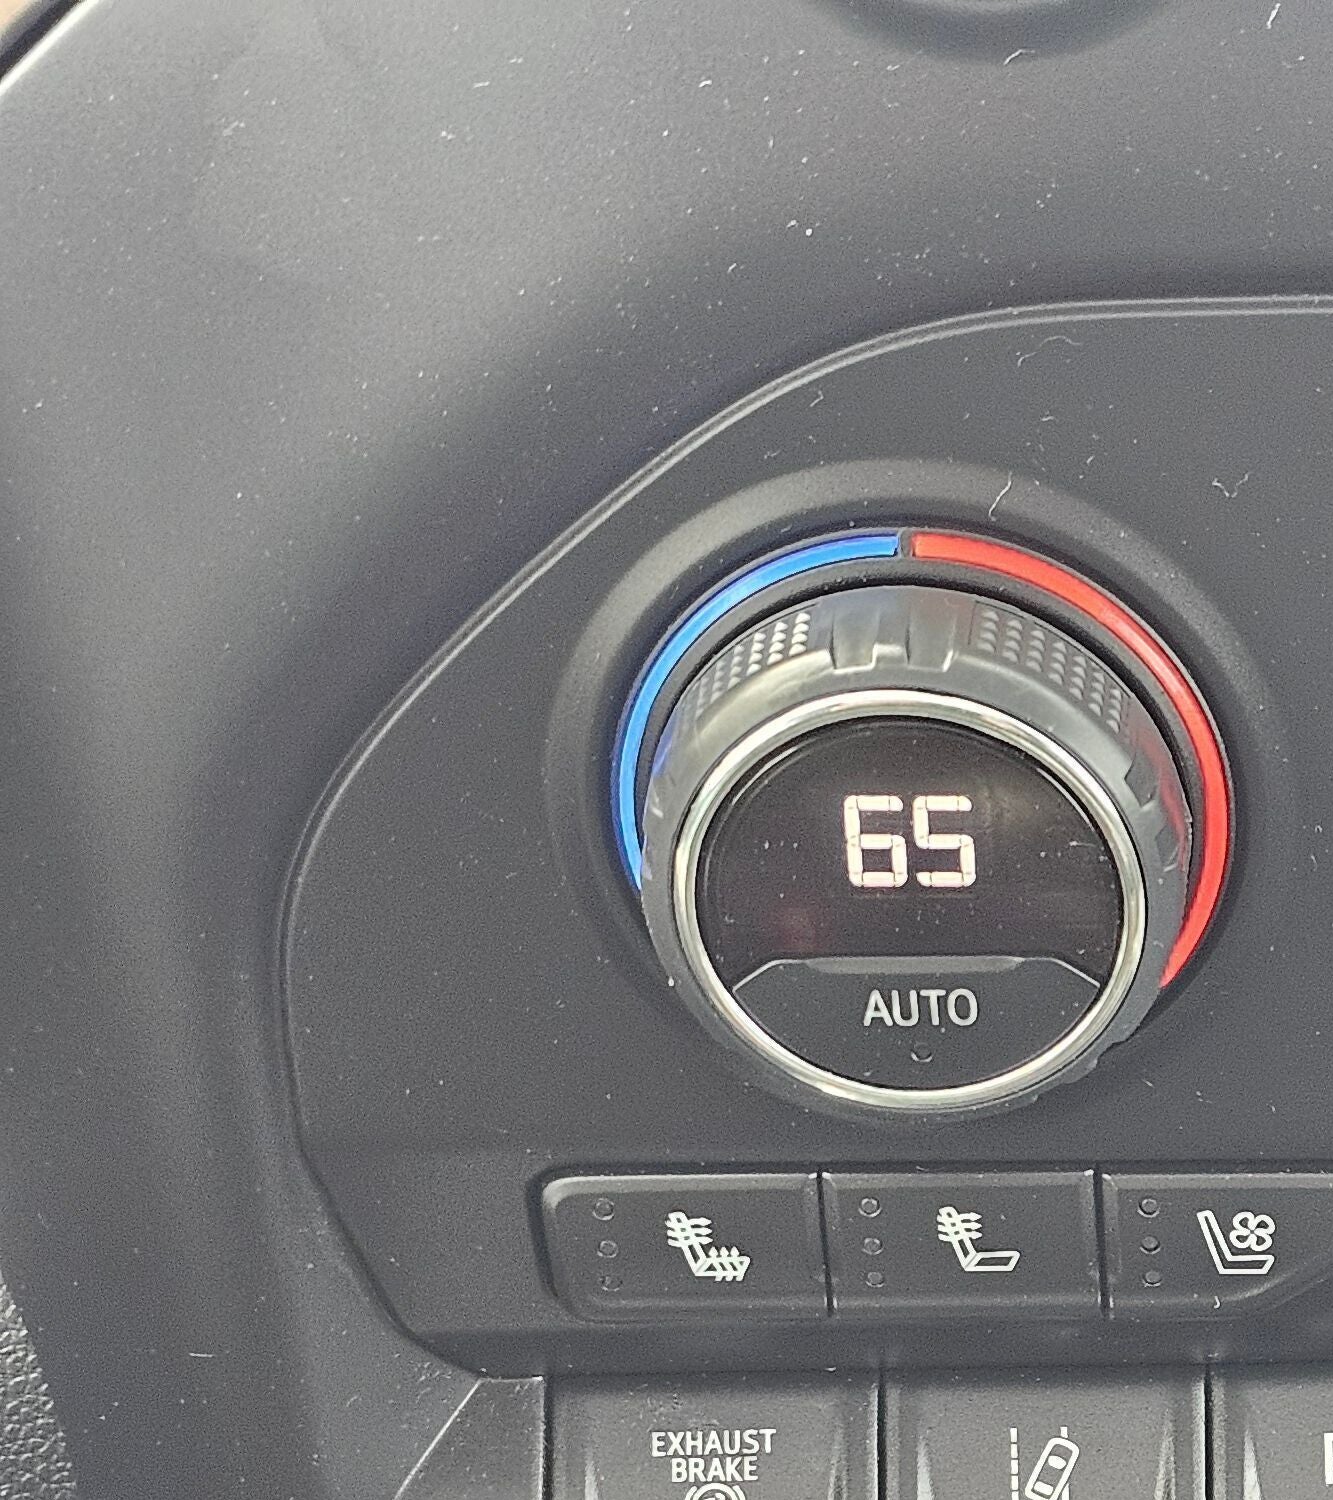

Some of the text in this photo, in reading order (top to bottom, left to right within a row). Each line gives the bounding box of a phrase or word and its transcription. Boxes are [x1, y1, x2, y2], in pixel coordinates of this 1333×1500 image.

[843, 794, 977, 888] 65
[863, 988, 978, 1027] AUTO
[651, 1428, 777, 1458] EXHAUST
[671, 1456, 758, 1482] BRAKE
